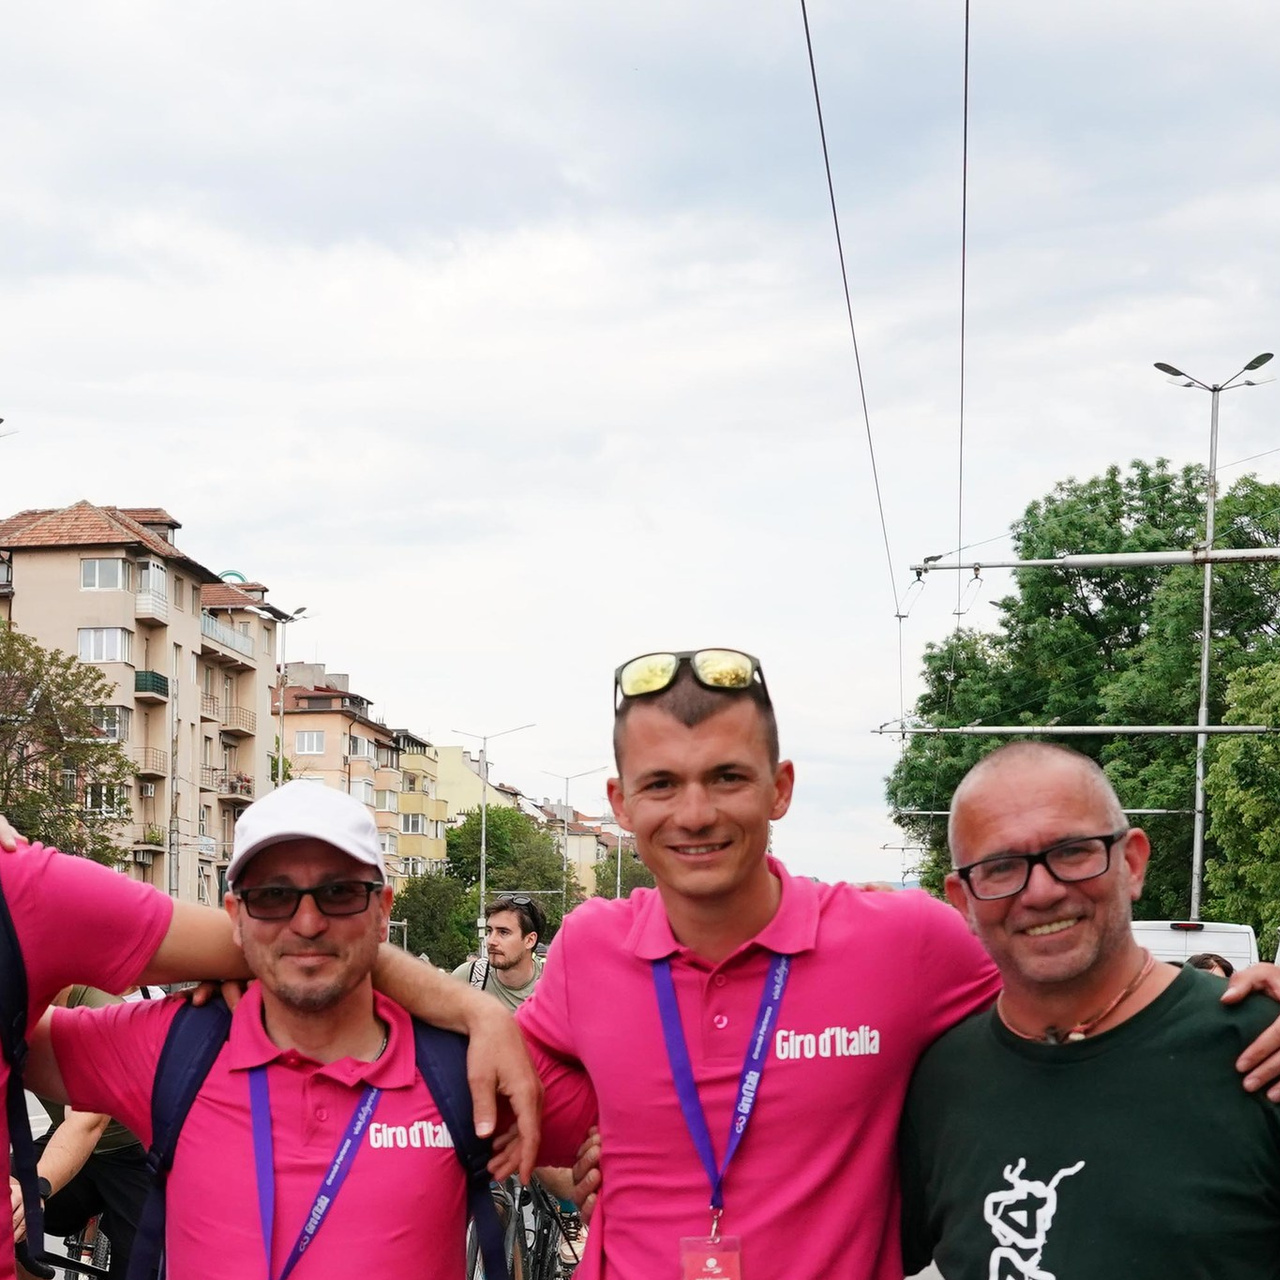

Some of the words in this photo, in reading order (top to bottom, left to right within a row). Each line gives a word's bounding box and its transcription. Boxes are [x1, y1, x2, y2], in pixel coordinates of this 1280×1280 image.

[775, 1029, 816, 1060] Giro
[818, 1025, 880, 1058] d'Italia
[738, 1093, 753, 1113] Giro
[369, 1122, 408, 1149] Giro
